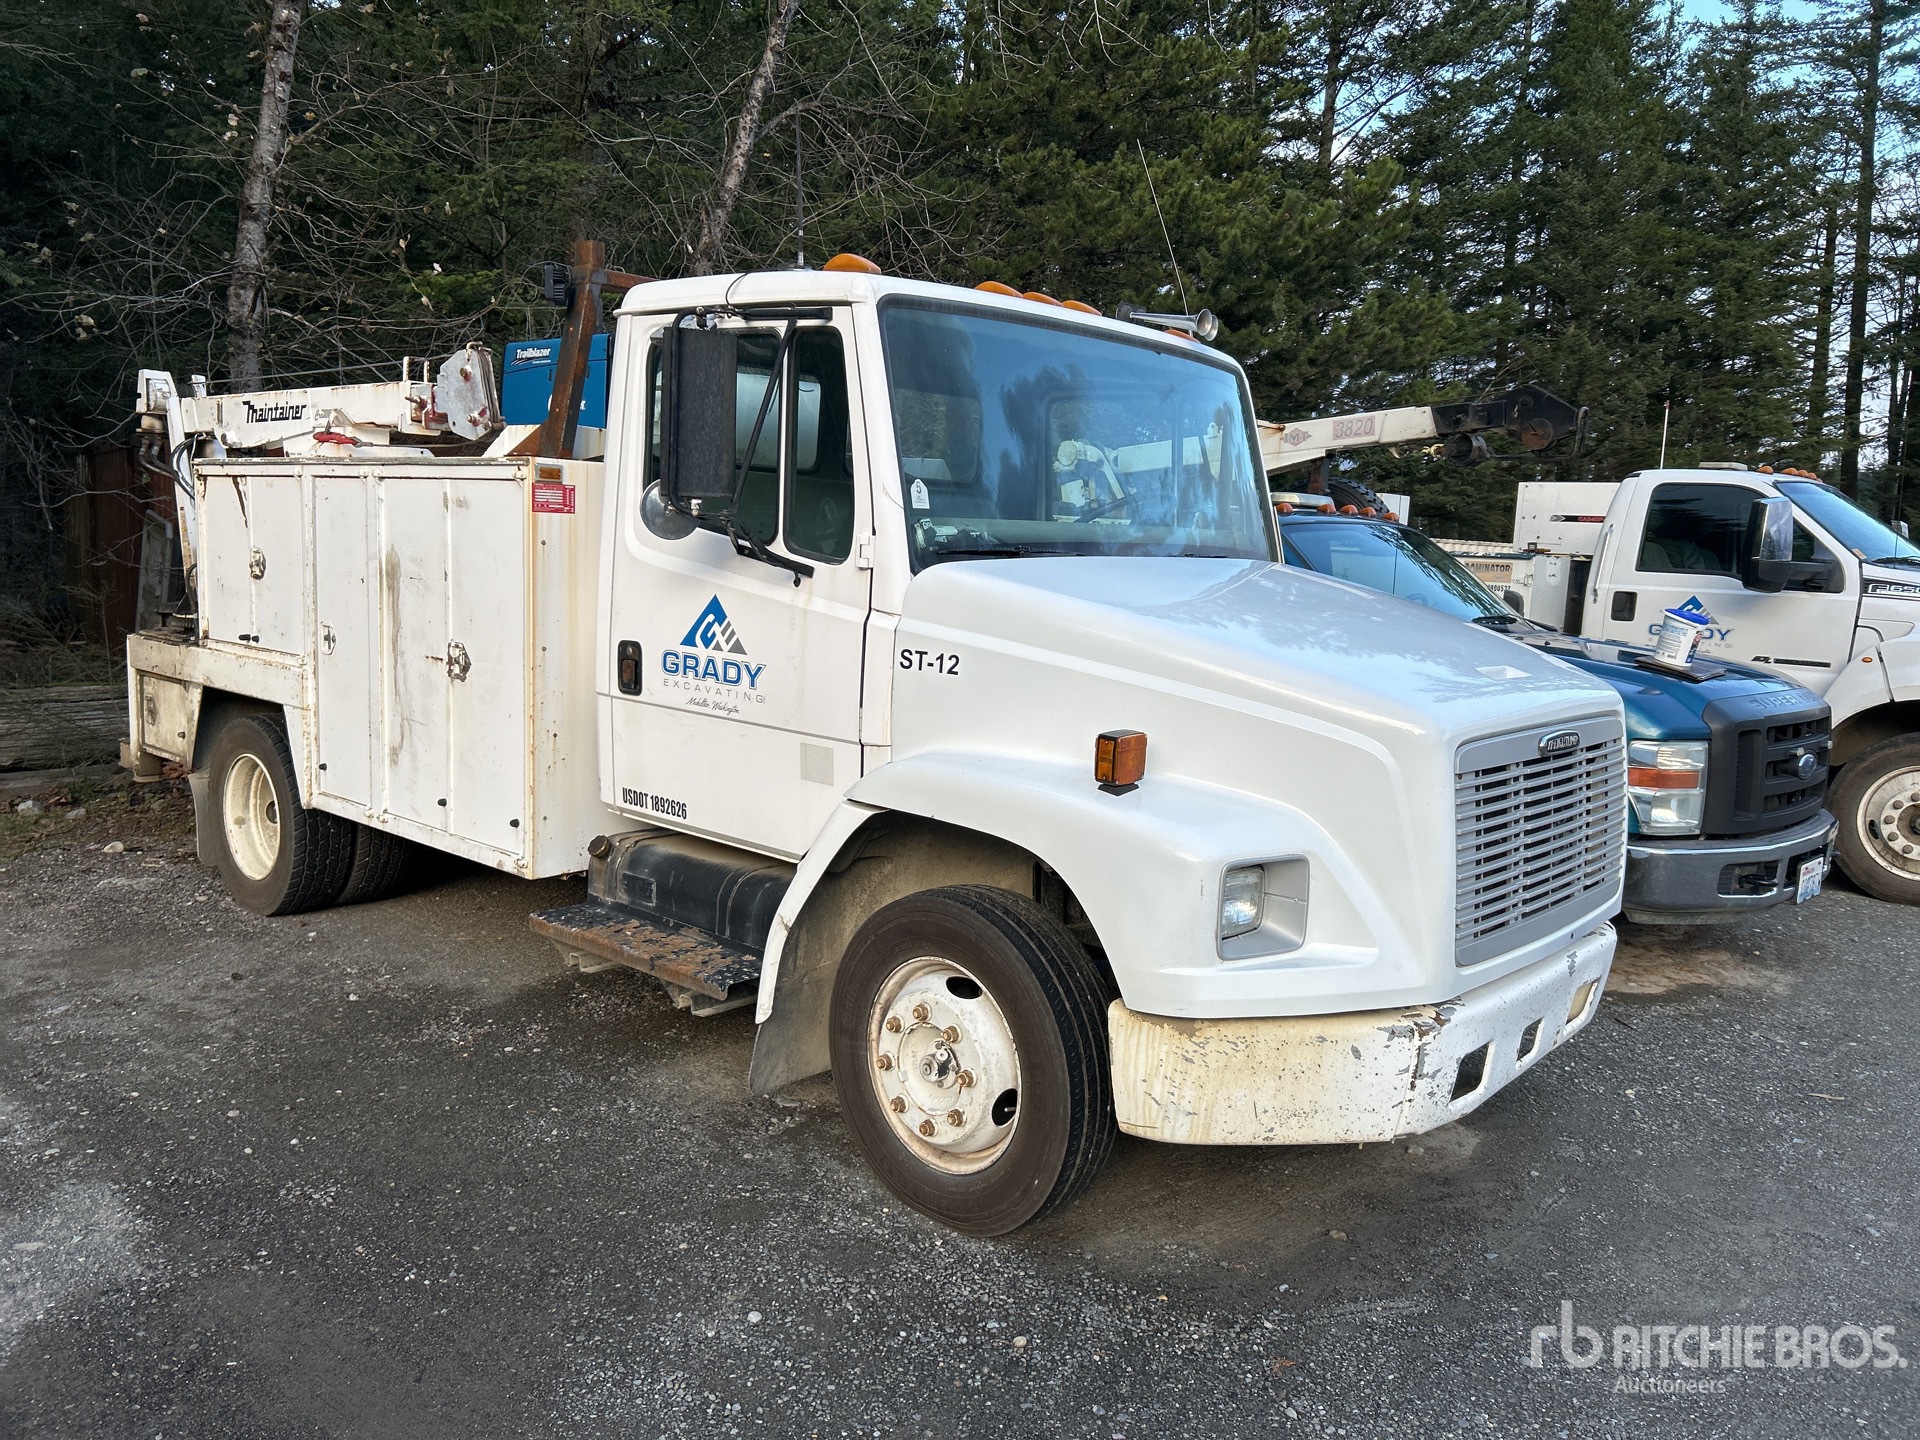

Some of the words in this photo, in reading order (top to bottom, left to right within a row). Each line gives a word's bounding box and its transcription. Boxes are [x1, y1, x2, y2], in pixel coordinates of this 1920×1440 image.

[516, 347, 551, 359] Trailblazer
[242, 400, 307, 424] Maintainer
[1334, 417, 1375, 439] 3820
[1648, 622, 1735, 642] GDY
[661, 649, 767, 690] GRADY
[899, 648, 960, 676] ST-12
[663, 678, 764, 704] EXCAVATING
[622, 786, 649, 810] USDOT
[650, 794, 687, 820] 1892626
